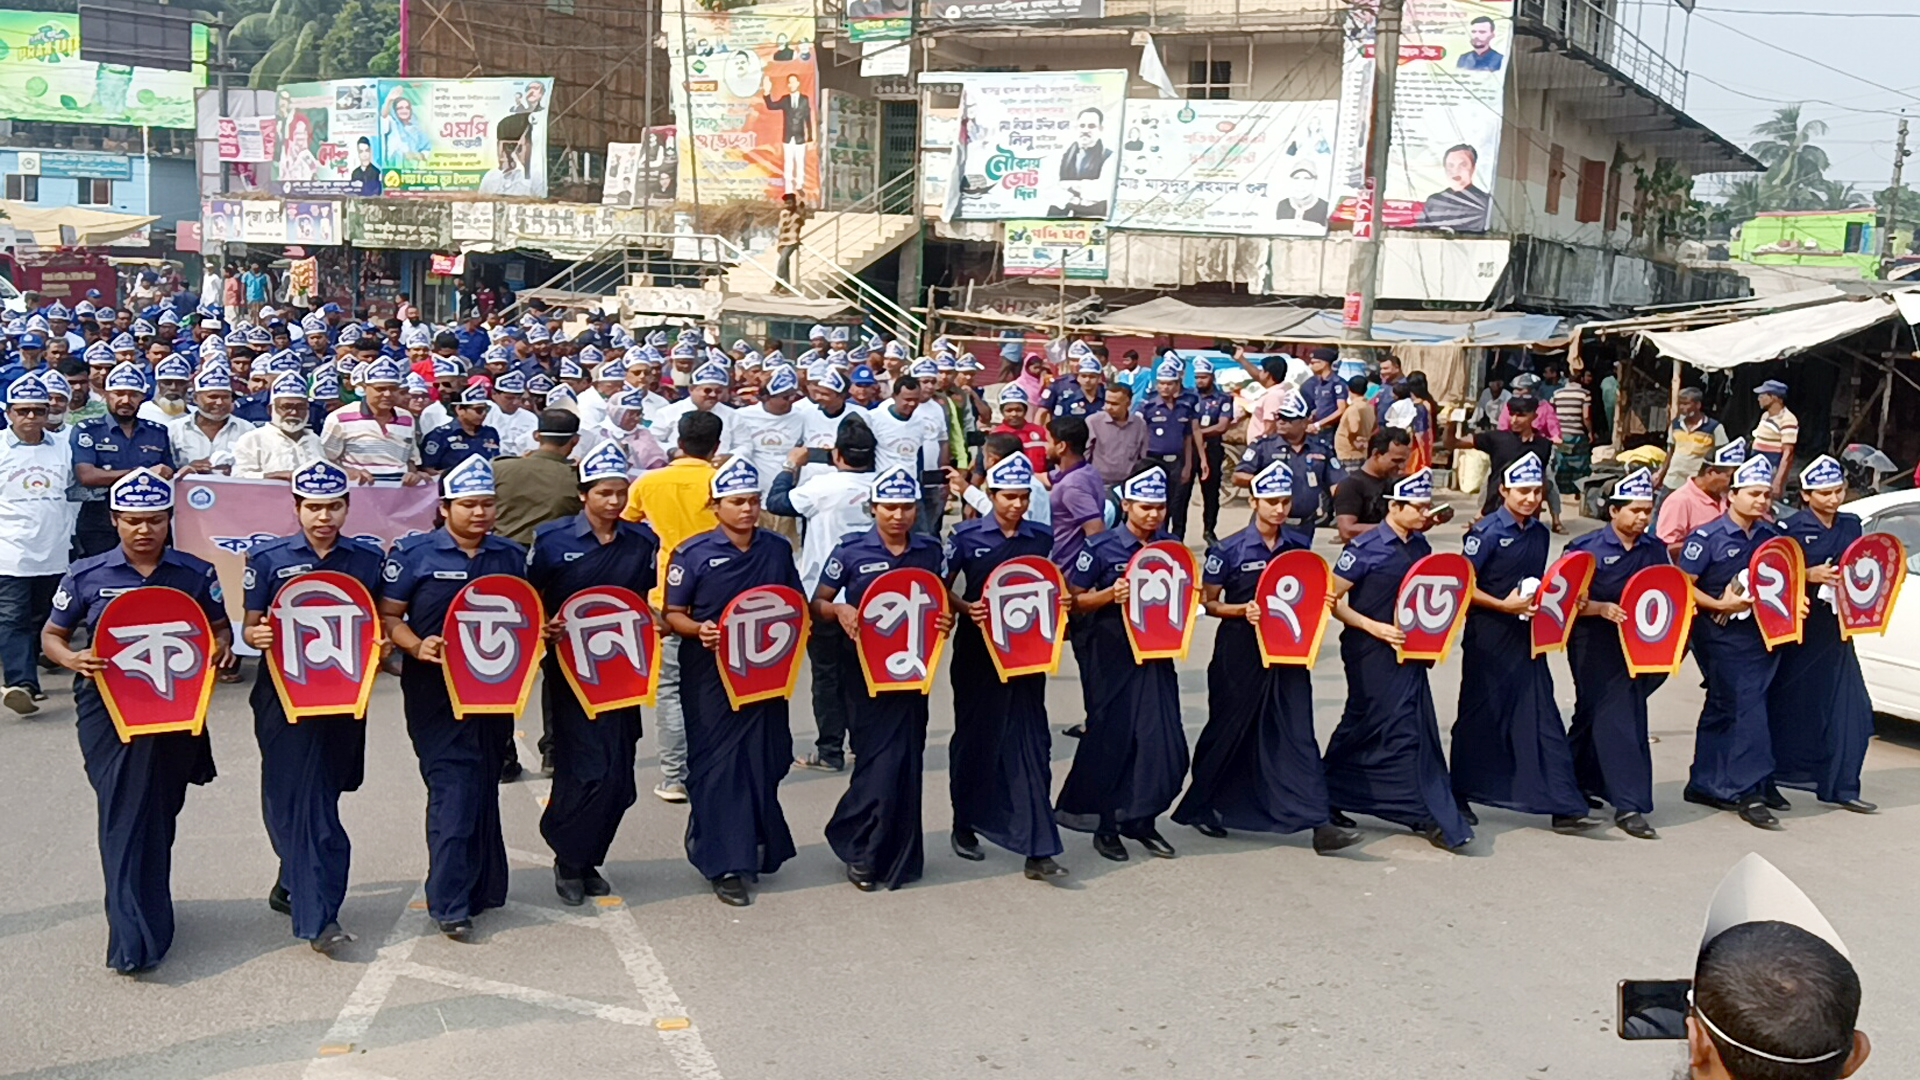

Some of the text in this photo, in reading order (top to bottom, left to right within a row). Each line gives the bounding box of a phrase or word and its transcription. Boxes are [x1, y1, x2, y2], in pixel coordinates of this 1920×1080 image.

[440, 115, 490, 138] এমপি
[1009, 131, 1035, 151] নিলু
[985, 144, 1046, 181] নৌকায়
[1002, 170, 1039, 190] ভোট
[1195, 180, 1240, 194] রহমান
[1014, 186, 1038, 201] দিন
[983, 564, 1061, 651] লি
[1127, 549, 1190, 630] শি
[1397, 575, 1461, 634] ডে
[1541, 574, 1571, 627] ২
[1756, 563, 1791, 619] ২
[1843, 557, 1884, 610] ৩
[271, 580, 370, 685] মি
[455, 585, 529, 684] উ
[563, 593, 648, 685] নি
[725, 590, 800, 677] টি
[863, 581, 937, 681] পু
[1635, 588, 1674, 643] ০
[108, 621, 202, 700] ক
